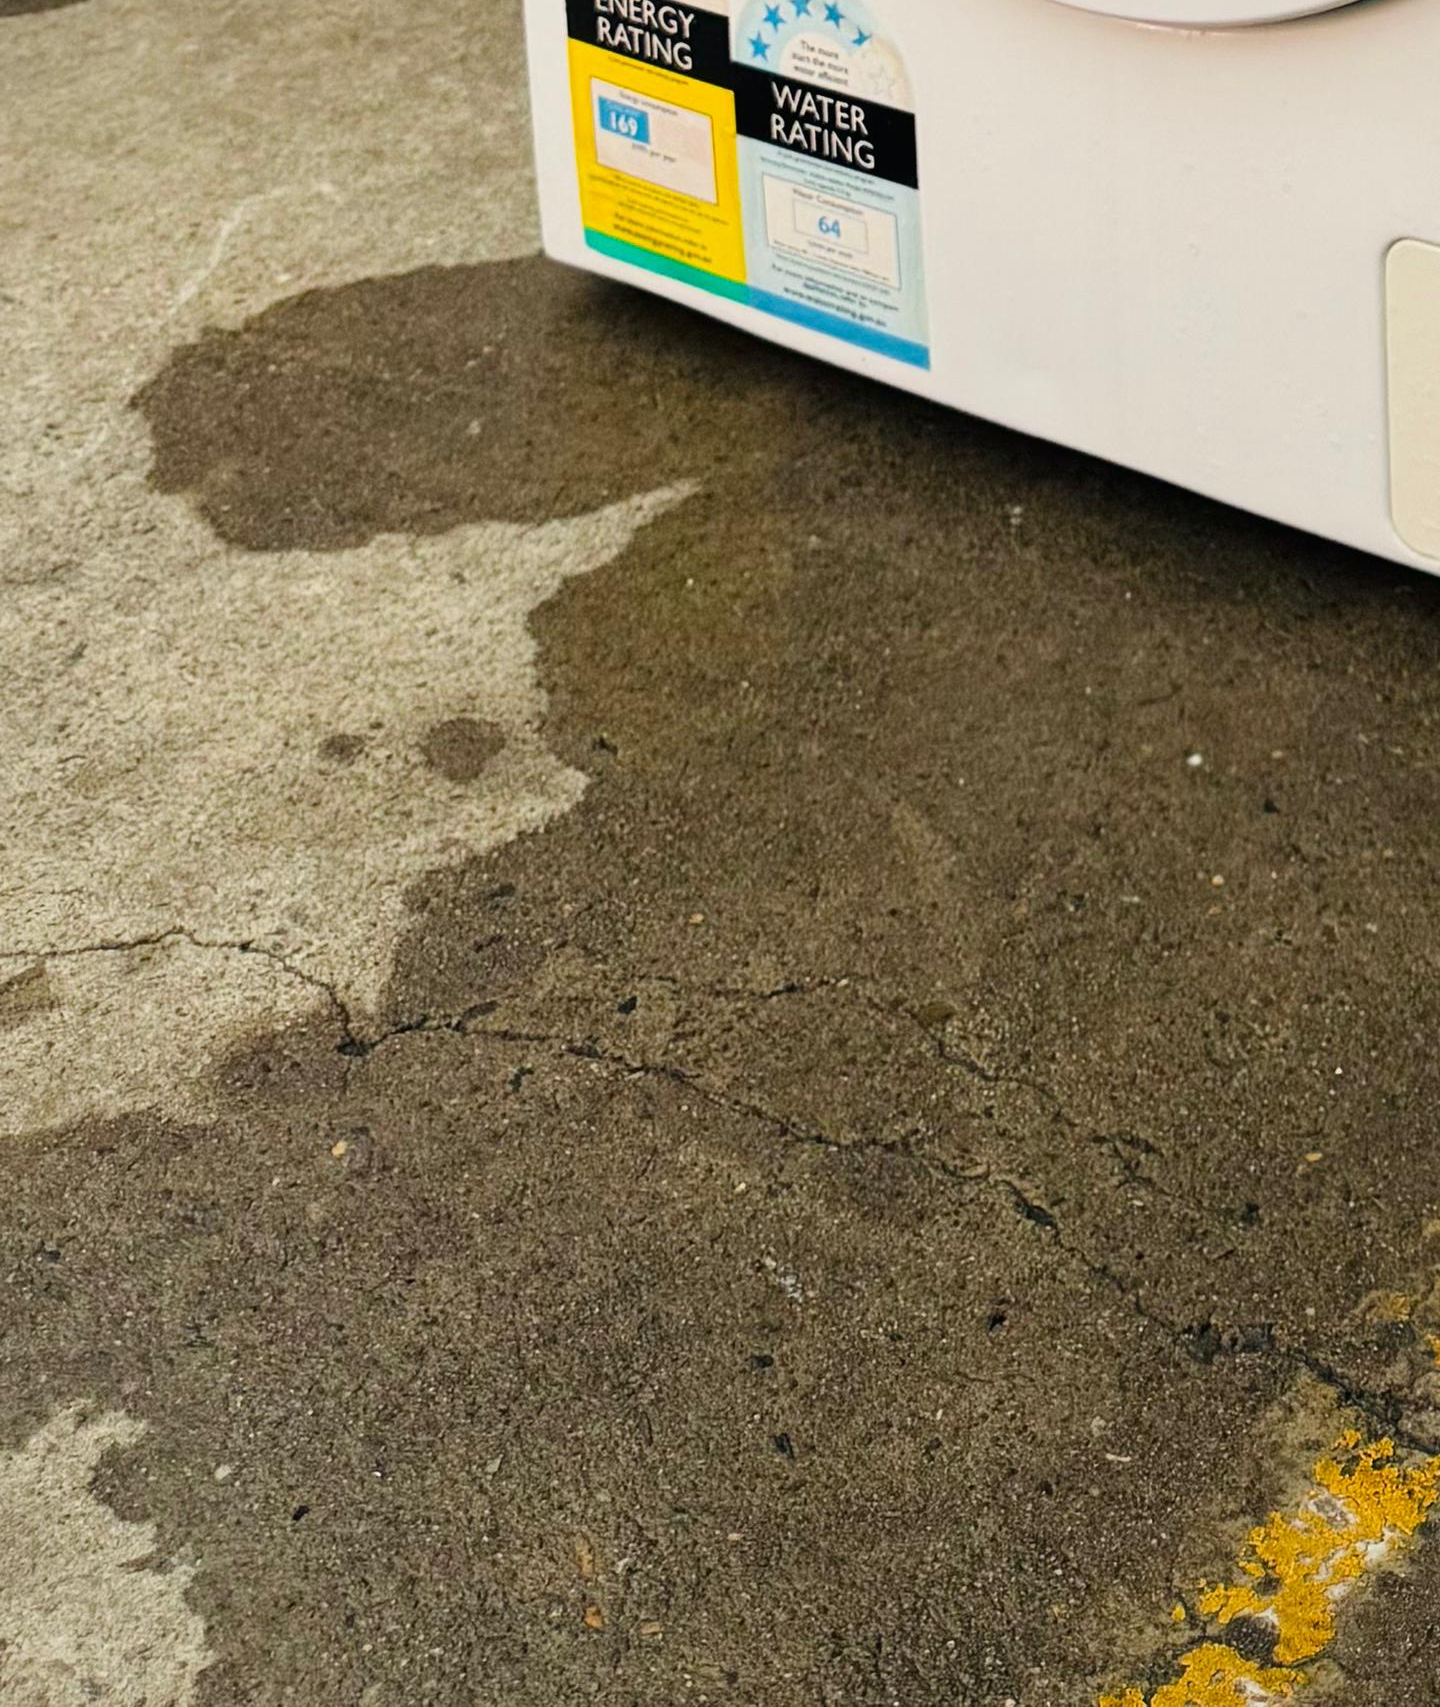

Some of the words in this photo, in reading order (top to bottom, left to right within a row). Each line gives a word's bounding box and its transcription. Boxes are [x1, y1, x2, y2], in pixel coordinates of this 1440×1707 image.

[597, 15, 693, 70] RATING
[771, 81, 868, 136] WATER
[770, 113, 875, 170] RATING
[818, 215, 841, 238] 64
